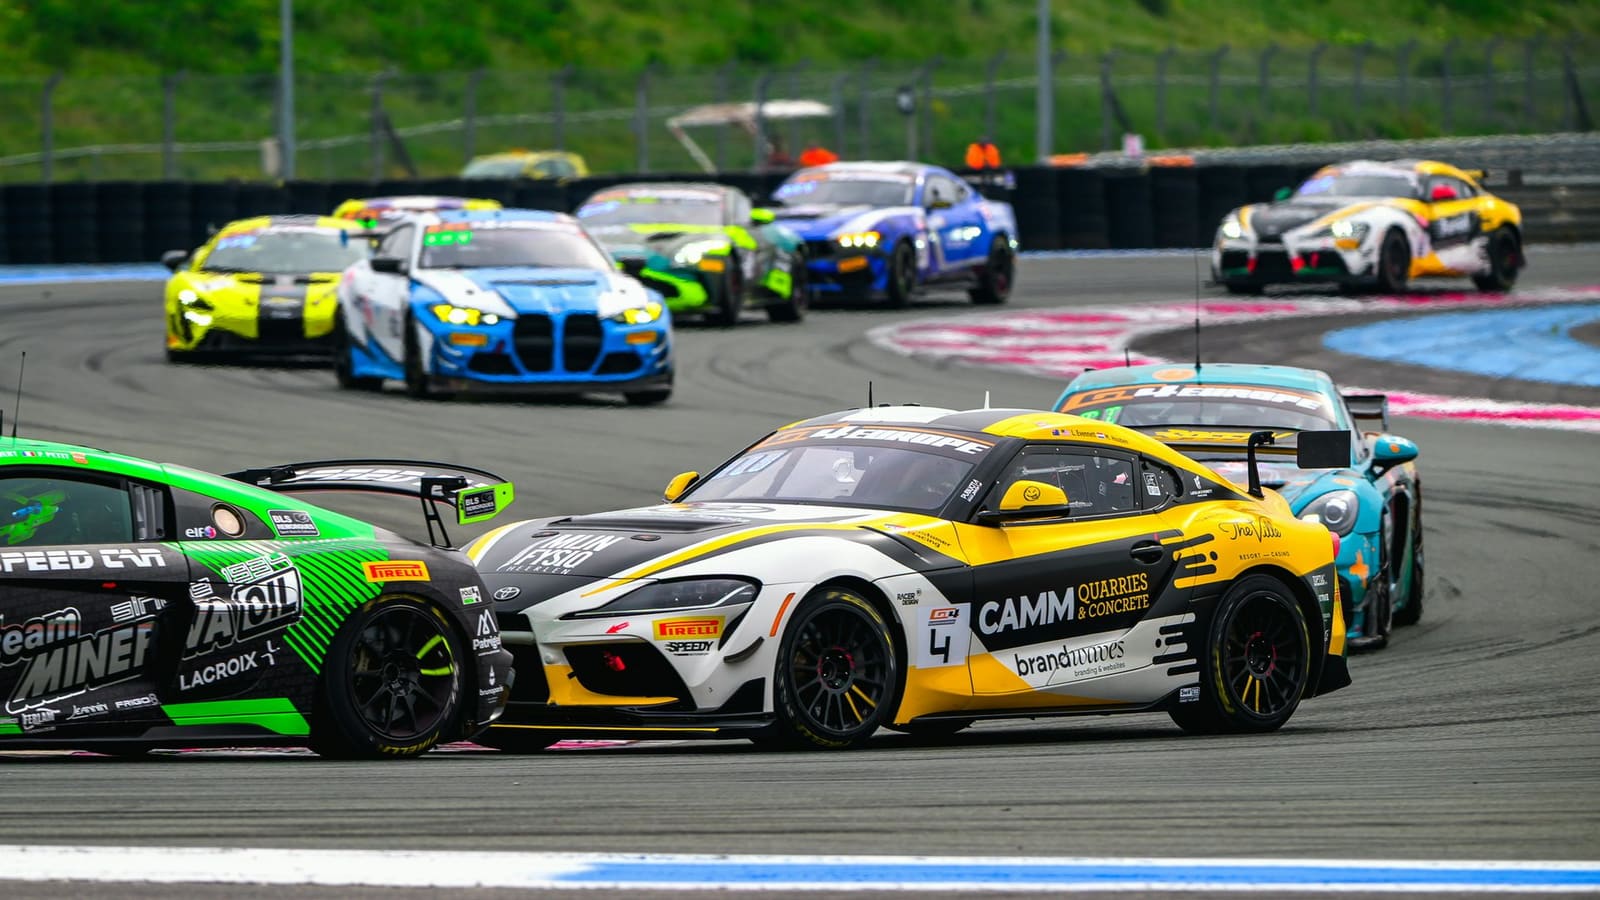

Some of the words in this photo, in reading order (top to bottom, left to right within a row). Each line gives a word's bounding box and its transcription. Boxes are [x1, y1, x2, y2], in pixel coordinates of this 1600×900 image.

[1177, 386, 1322, 411] EUROPE
[853, 429, 992, 455] EUROPE
[465, 497, 480, 506] BLS
[272, 515, 293, 523] BLS
[185, 527, 205, 538] elf
[1218, 522, 1251, 540] The
[0, 549, 94, 573] PEED
[100, 548, 166, 568] CAR
[515, 549, 593, 568] FYSIO
[370, 564, 424, 579] PIRELLI
[897, 592, 915, 600] RACER
[1078, 573, 1148, 603] QUARRIES
[979, 587, 1075, 635] CAMM
[1078, 608, 1086, 620] &
[1088, 594, 1149, 618] CONCRETE
[0, 613, 77, 655] eam
[659, 620, 719, 636] PIRELLI
[665, 641, 715, 653] SPEEDY
[930, 629, 951, 664] 4
[1015, 639, 1125, 677] brandwaves
[1074, 666, 1095, 677] branding
[1103, 661, 1125, 672] websites
[180, 651, 258, 691] LACROIX
